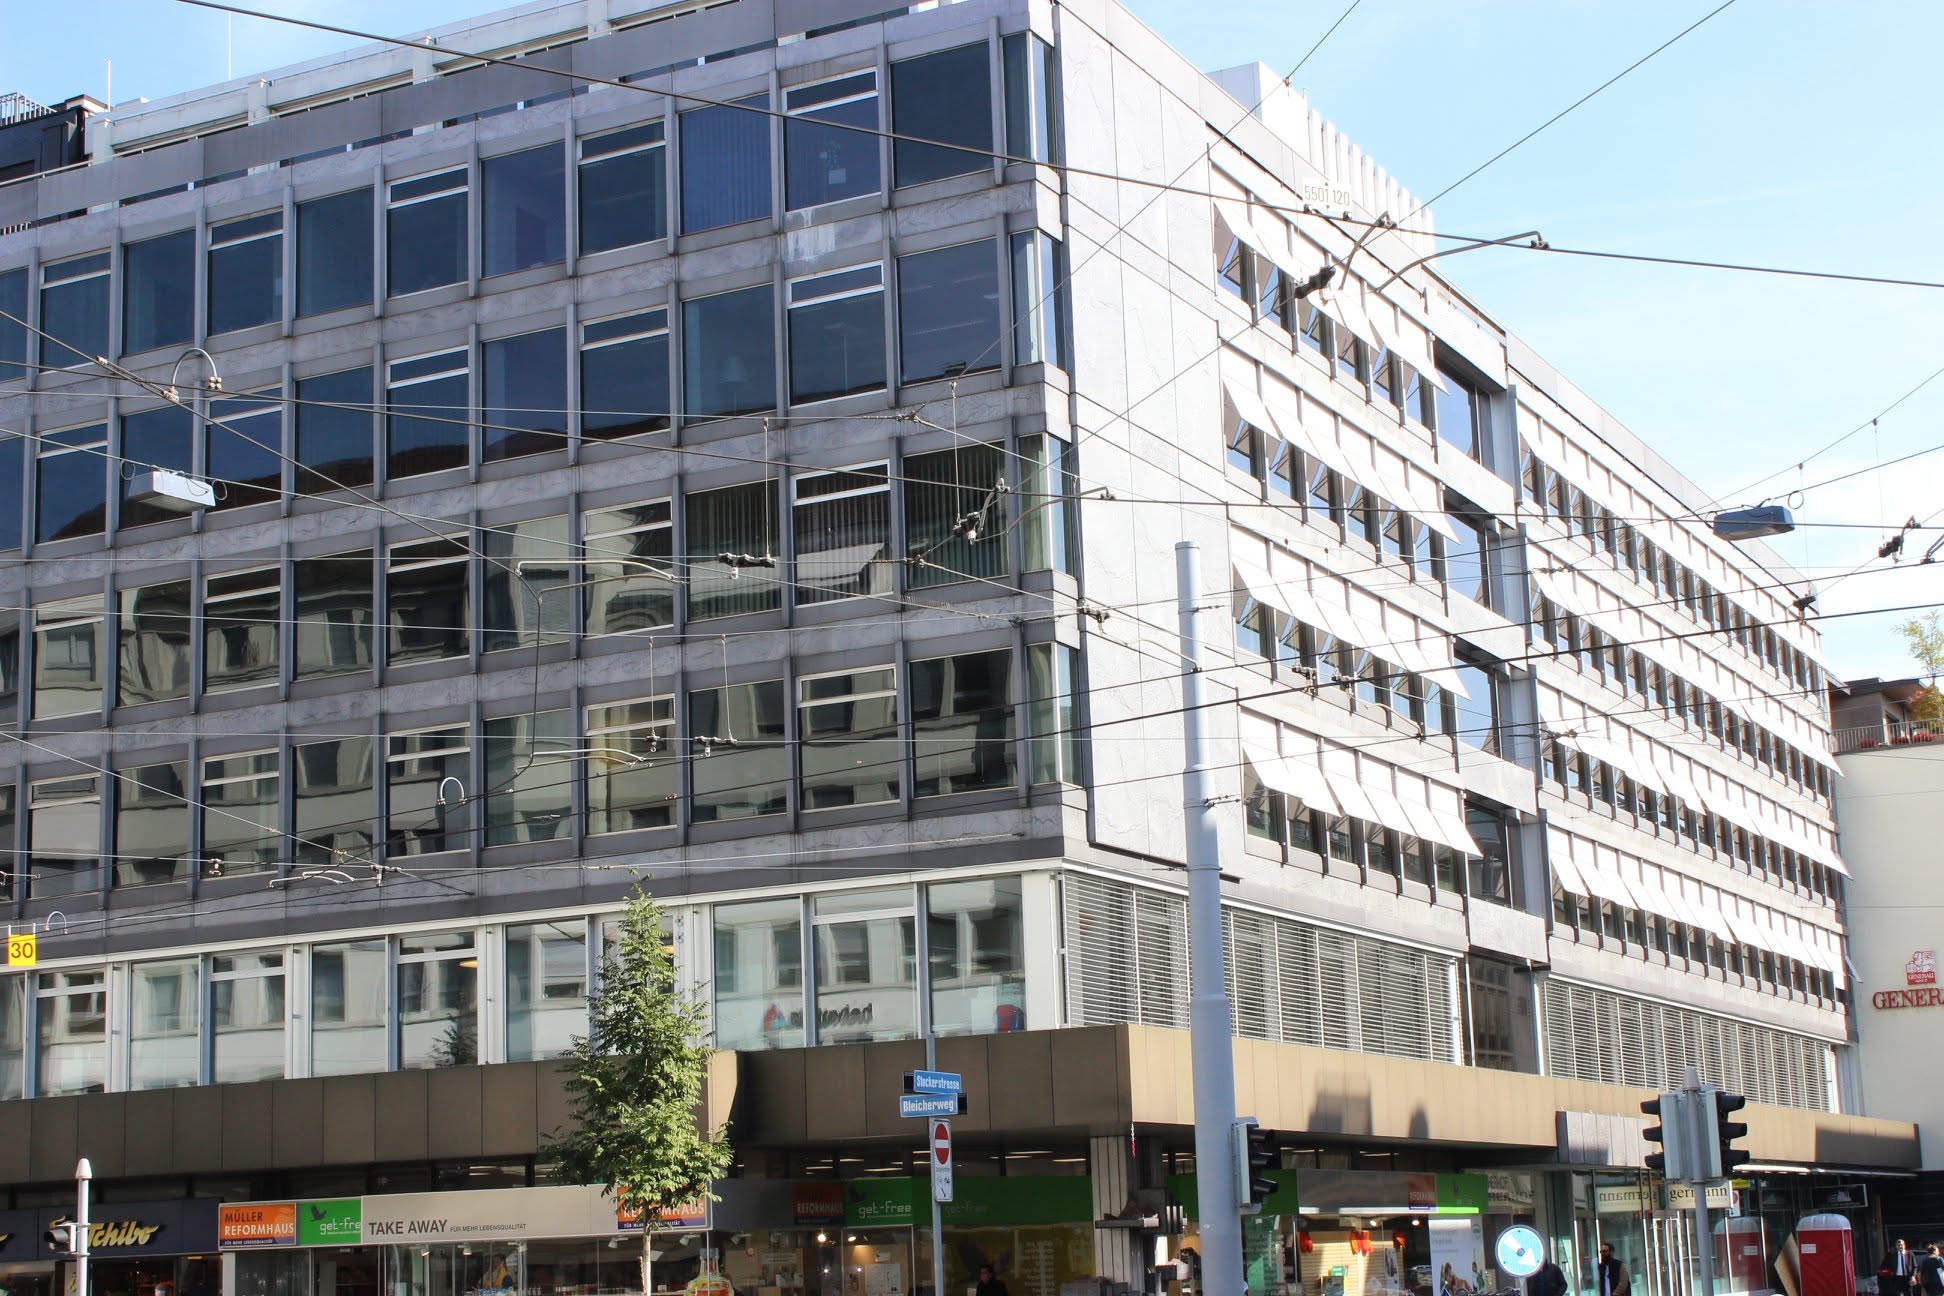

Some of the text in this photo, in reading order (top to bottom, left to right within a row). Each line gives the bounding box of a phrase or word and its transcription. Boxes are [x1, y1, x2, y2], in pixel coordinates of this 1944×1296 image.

[10, 942, 34, 959] 30
[1872, 987, 1944, 1010] GENER
[916, 1075, 960, 1090] Stockerstrasse
[903, 1100, 954, 1112] Bleicherweg
[1669, 1187, 1728, 1202] gerann
[225, 1210, 263, 1223] MÜLLER
[858, 1201, 912, 1219] get-free
[224, 1223, 294, 1236] REFORMHAUS
[368, 1221, 404, 1236] TAKE
[407, 1219, 448, 1234] AWAY
